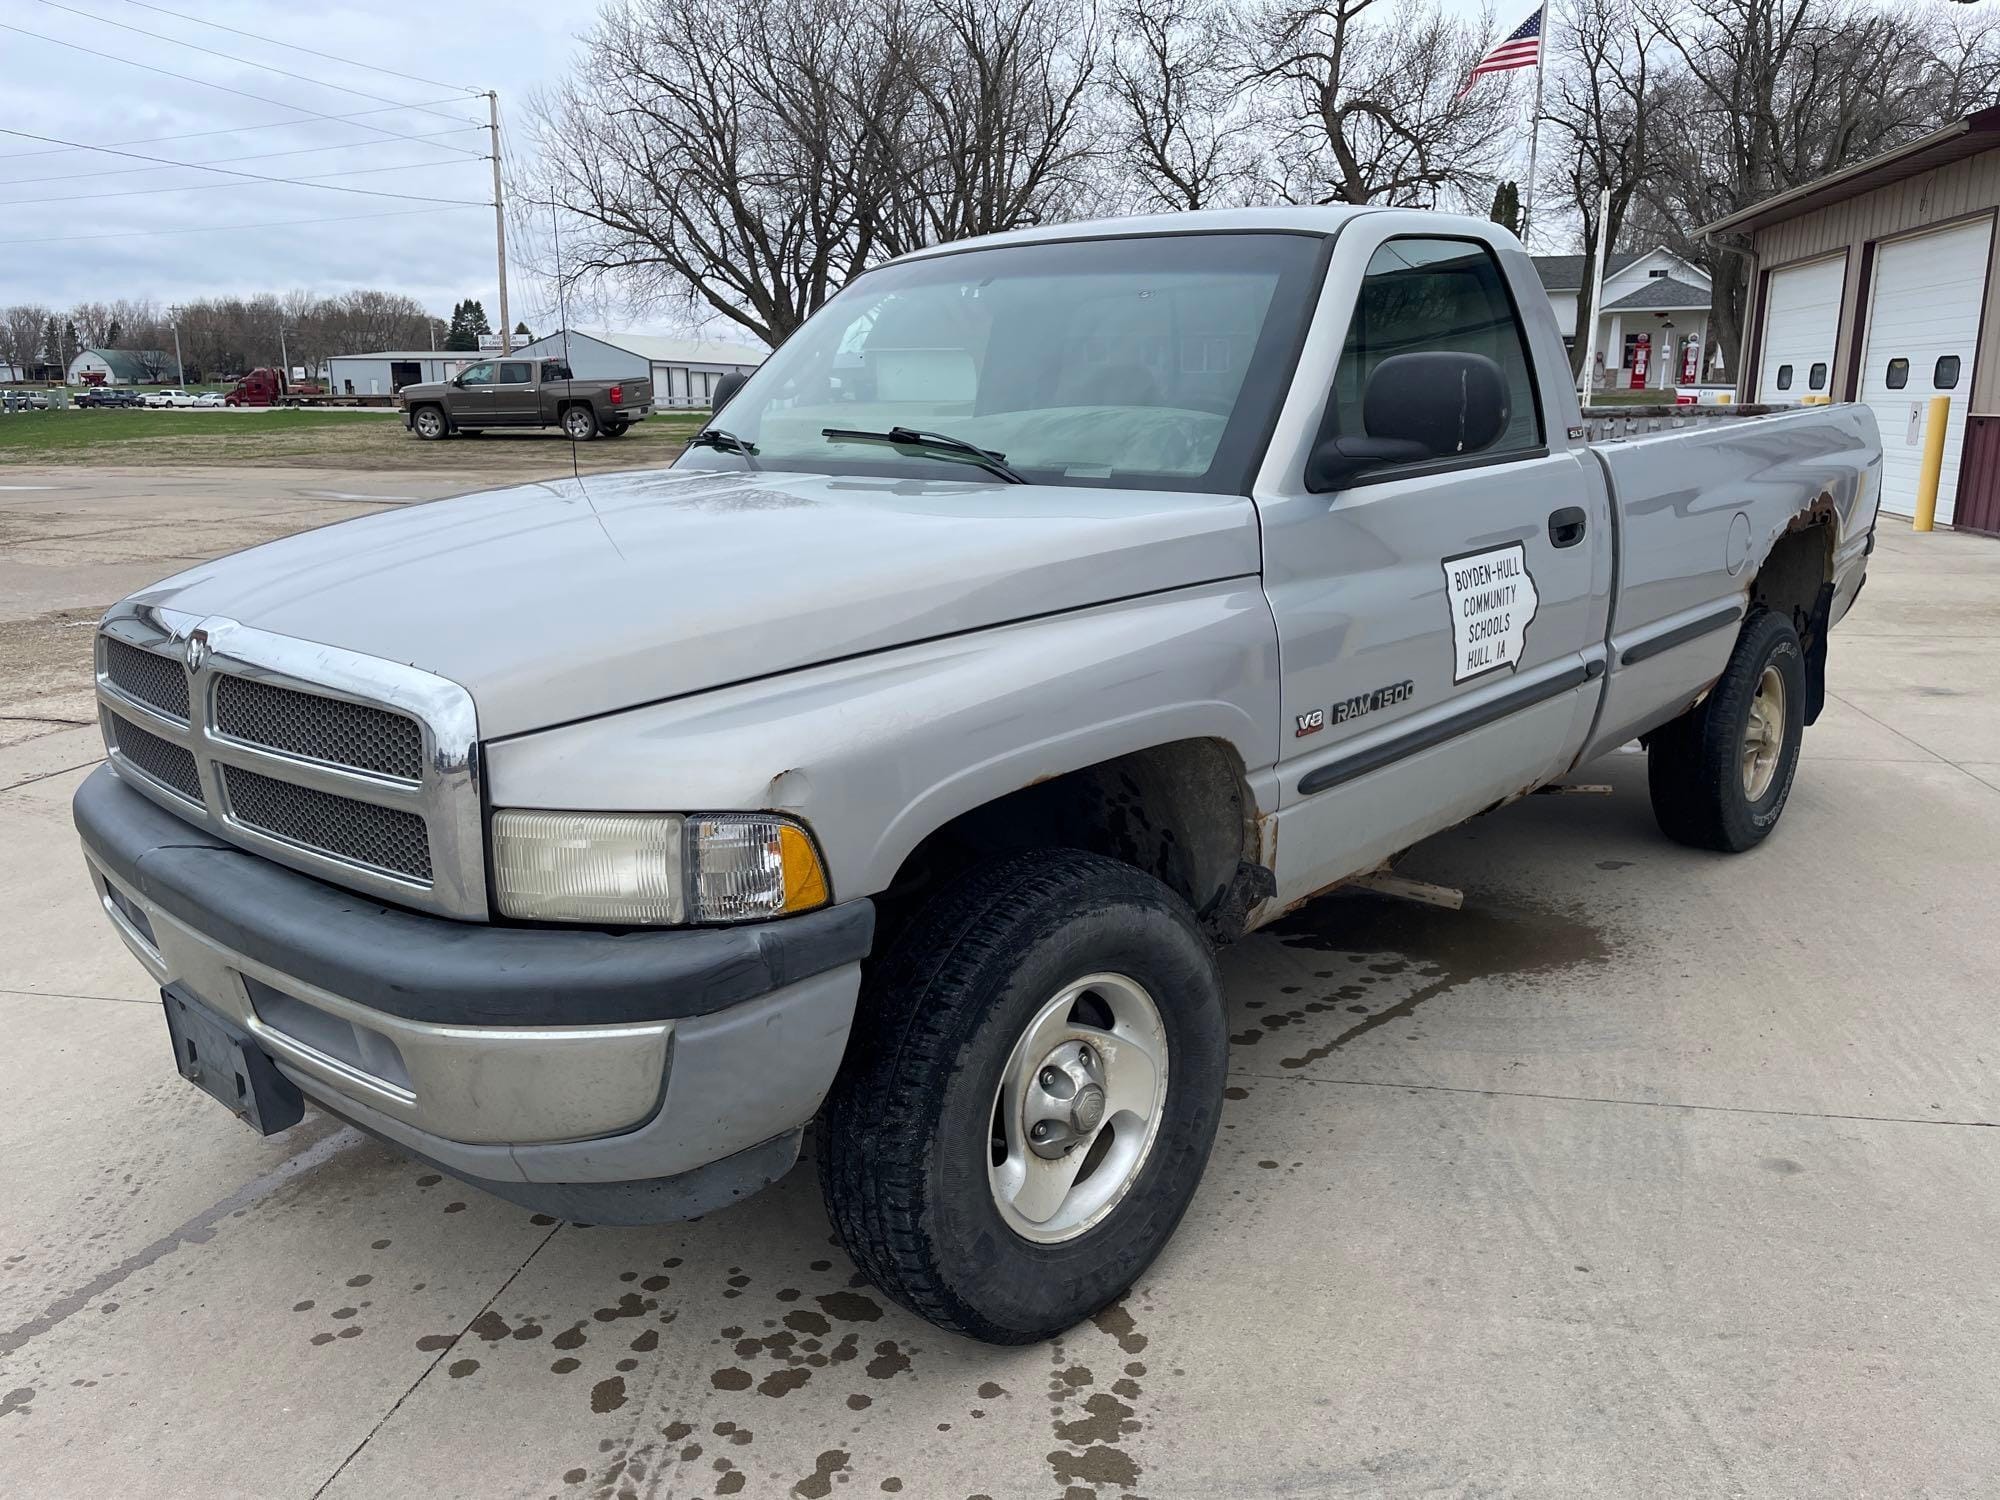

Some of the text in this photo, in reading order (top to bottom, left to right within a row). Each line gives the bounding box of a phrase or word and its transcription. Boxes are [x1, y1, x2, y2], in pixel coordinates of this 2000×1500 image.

[1569, 429, 1583, 438] SLT
[1455, 557, 1520, 592] BOYDEN-HULL
[1464, 584, 1517, 618] COMMUNITY
[1469, 613, 1510, 643] SCHOOLS
[1496, 640, 1506, 659] IA
[1334, 680, 1415, 724] RAM 1500
[1297, 710, 1323, 730] V8
